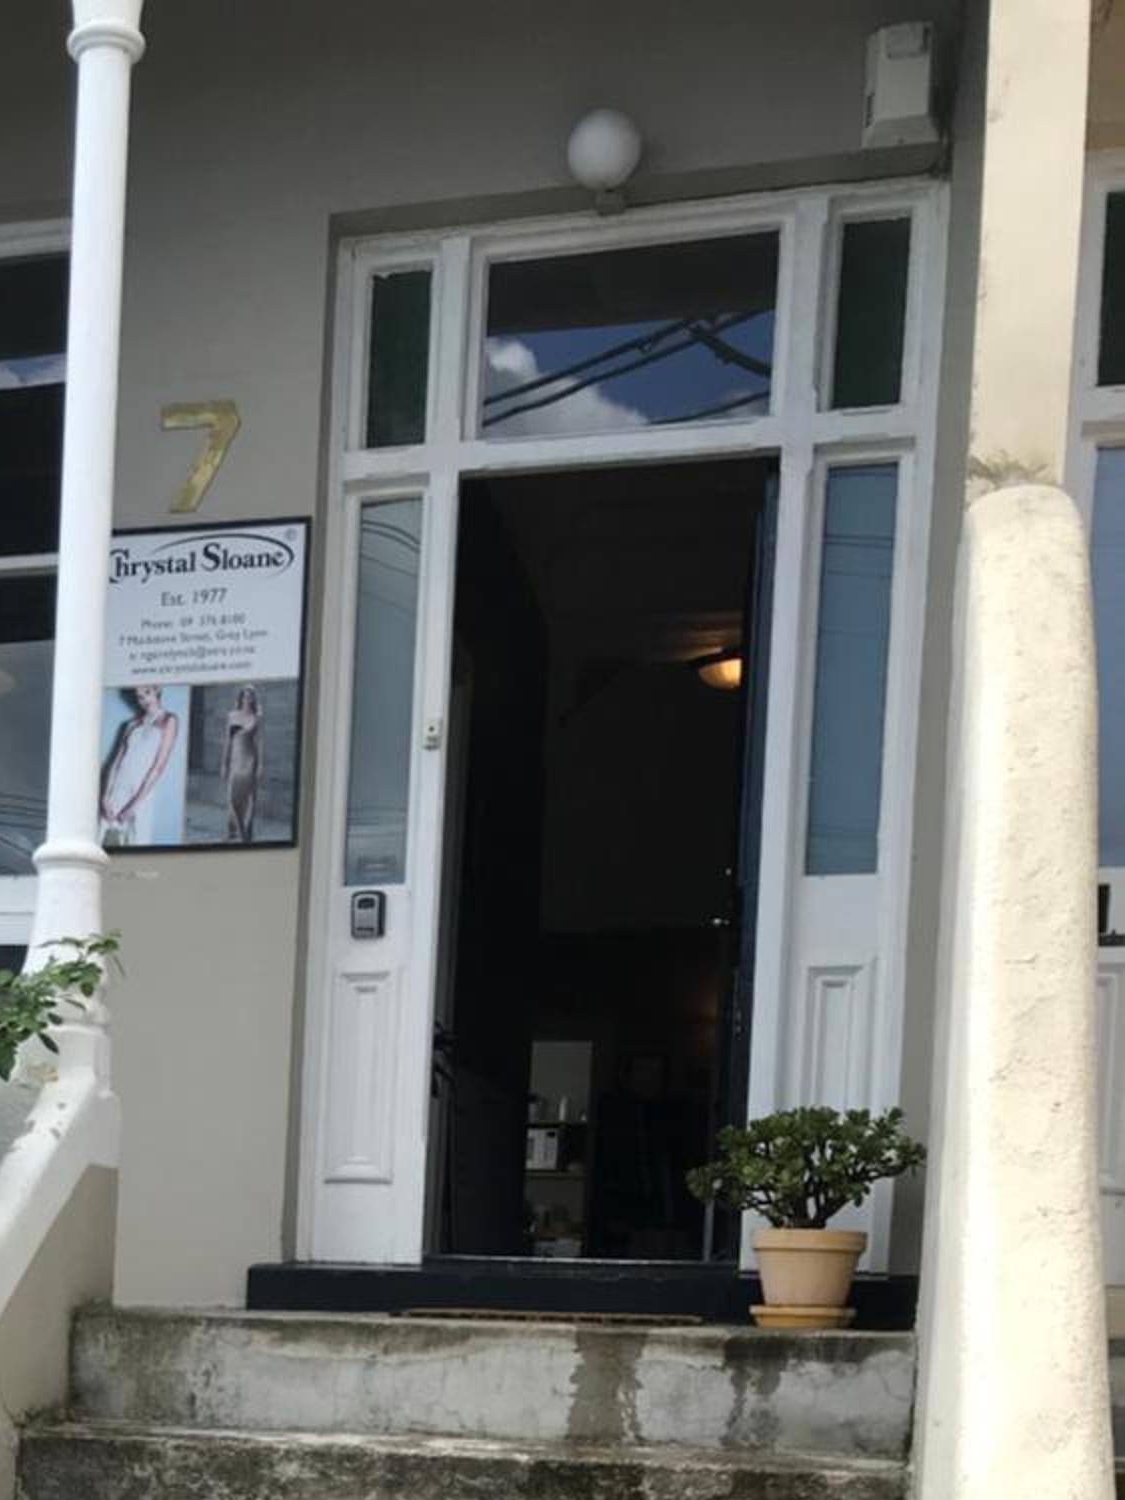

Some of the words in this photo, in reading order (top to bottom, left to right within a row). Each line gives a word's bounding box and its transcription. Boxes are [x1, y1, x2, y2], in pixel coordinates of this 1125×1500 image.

[159, 399, 242, 514] 7
[109, 548, 196, 584] Chrystal
[200, 541, 285, 572] Sloane
[191, 588, 228, 606] 1977
